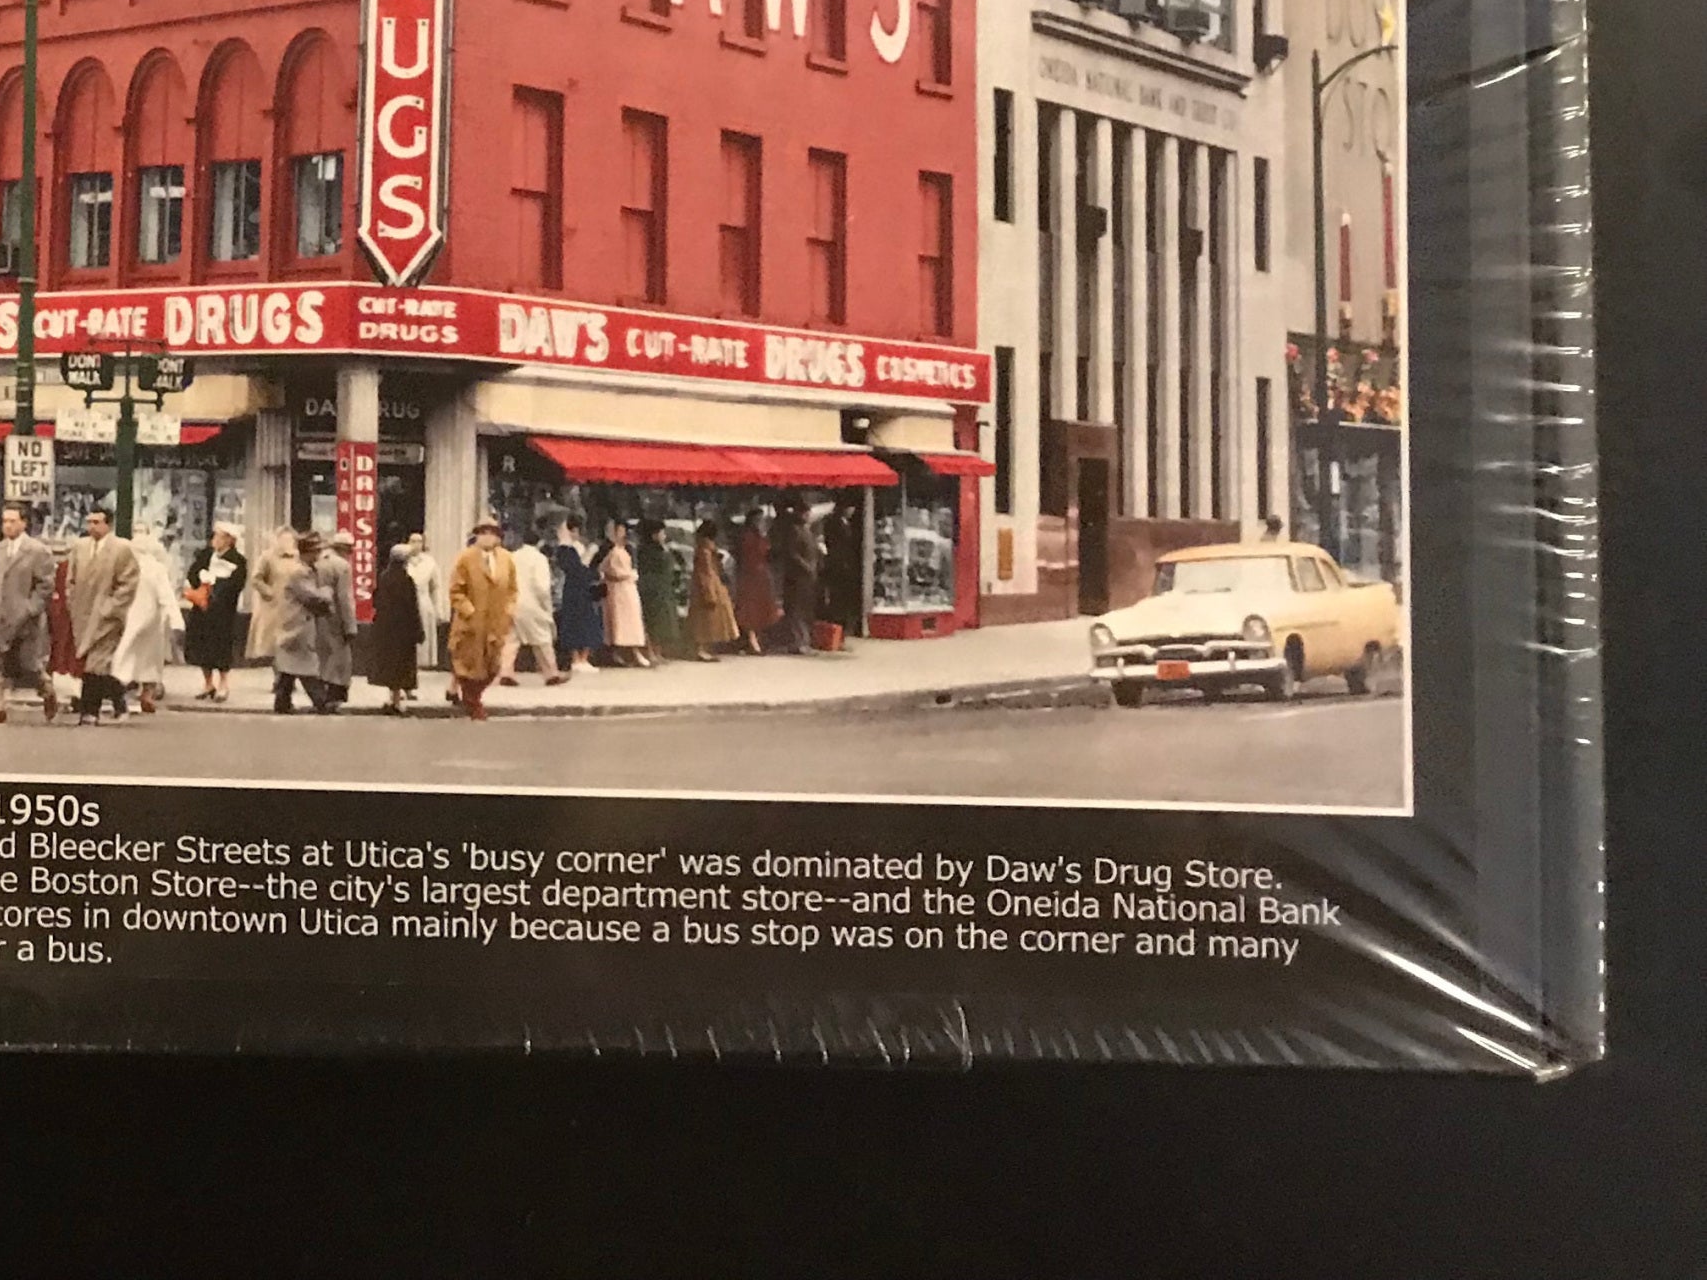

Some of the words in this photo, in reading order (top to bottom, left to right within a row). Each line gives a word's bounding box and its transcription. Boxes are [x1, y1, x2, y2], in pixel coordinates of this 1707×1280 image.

[33, 307, 149, 339] CUT-RATE
[163, 289, 326, 345] DRUGS
[358, 295, 458, 320] CUT-RATE
[358, 322, 460, 344] DRUGS
[499, 303, 610, 363] DAW'S
[625, 328, 750, 370] CUT-RATE
[765, 334, 867, 388] DRUGS
[875, 354, 977, 390] COSMETICS
[379, 401, 421, 419] RUG
[17, 441, 42, 458] NO
[11, 460, 49, 478] LEFT
[10, 479, 50, 497] TURN
[30, 831, 166, 862] Bleecker
[176, 835, 291, 866] Streets
[302, 840, 334, 867] at
[345, 840, 450, 870] Utica's
[462, 842, 545, 878] 'busy
[556, 846, 666, 874] corner'
[679, 854, 741, 876] was
[752, 849, 923, 880] dominated
[936, 853, 974, 888] by
[987, 855, 1082, 884] Daw's
[1094, 857, 1172, 893] Drug
[1185, 859, 1282, 890] Store.
[31, 866, 139, 896] Boston
[151, 868, 318, 900] Store--the
[329, 874, 410, 909] city's
[422, 875, 531, 910] largest
[542, 878, 732, 914] department
[742, 884, 911, 914] store--and
[922, 886, 976, 915] the
[986, 888, 1100, 919] Oneida
[1113, 892, 1245, 923] National
[1259, 896, 1342, 927] Bank
[84, 900, 110, 929] in
[122, 901, 287, 934] downtown
[300, 907, 379, 937] Utica
[392, 908, 498, 946] mainly
[510, 911, 641, 942] because
[652, 921, 670, 943] a
[683, 915, 740, 945] bus
[751, 918, 820, 952] stop
[830, 925, 894, 948] was
[905, 927, 943, 949] on
[955, 921, 1008, 951] the
[1019, 930, 1125, 954] corner
[1135, 928, 1195, 956] and
[1208, 935, 1299, 966] many
[16, 940, 35, 962] a
[48, 934, 112, 964] bus.
